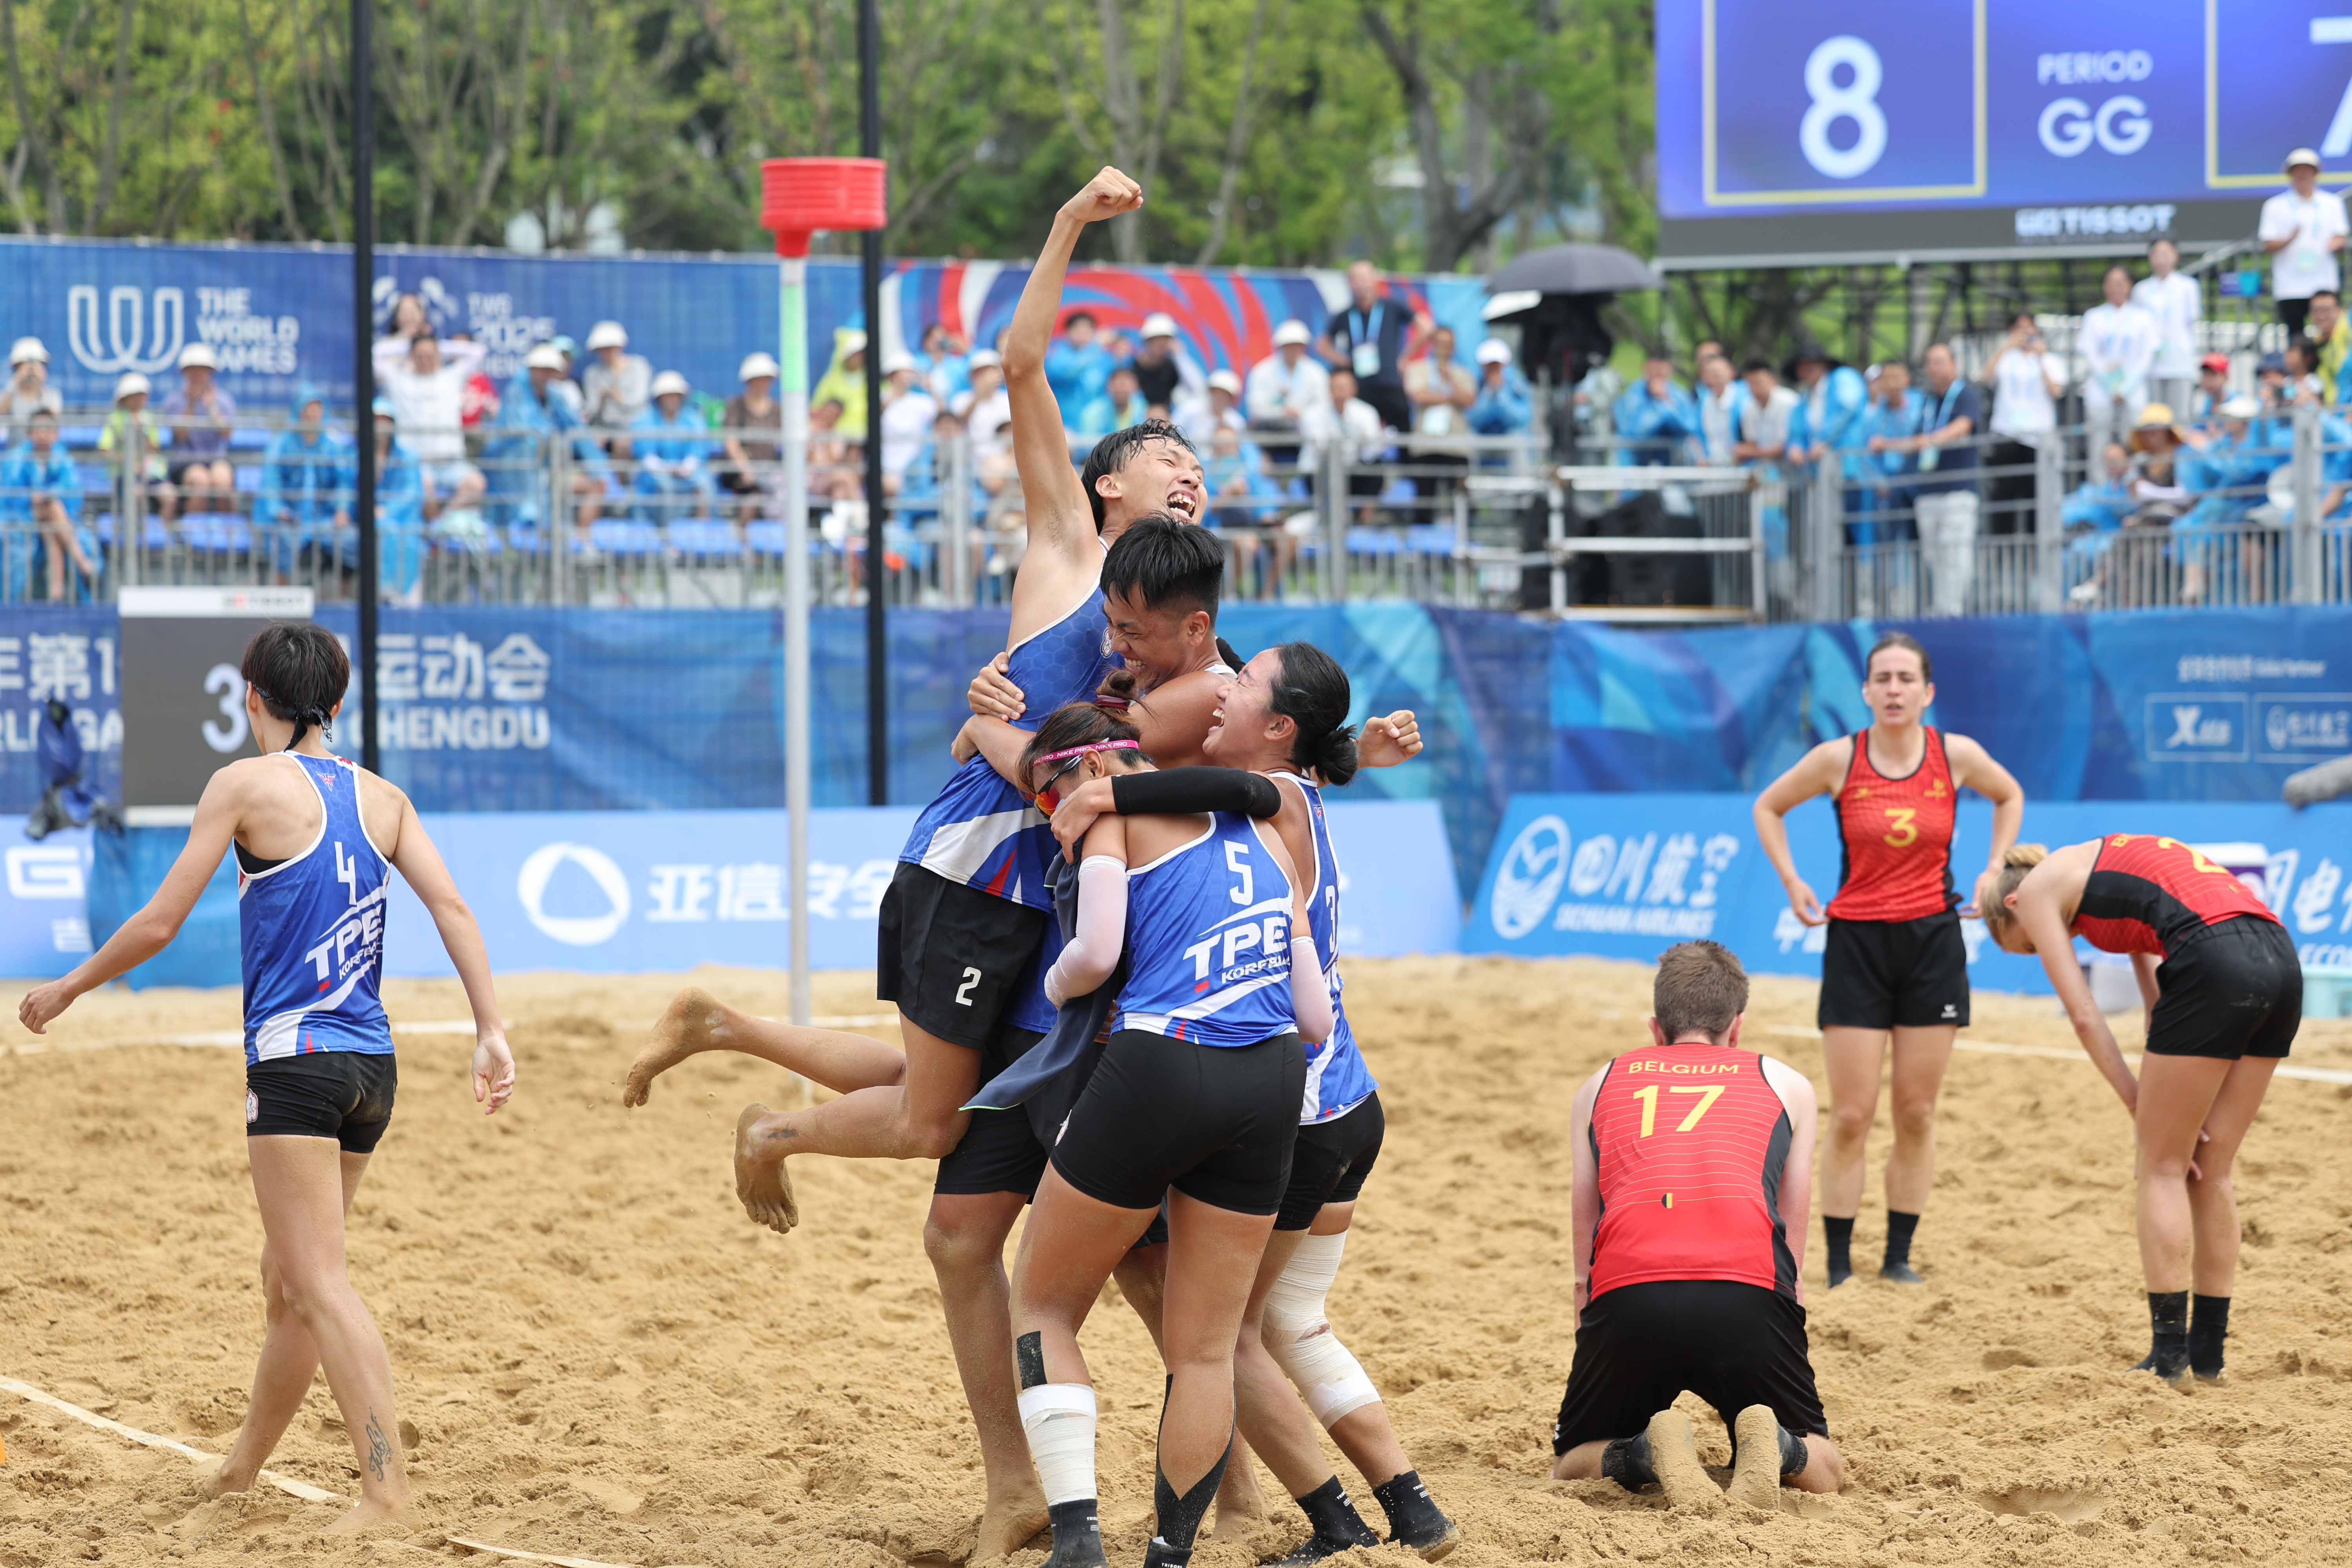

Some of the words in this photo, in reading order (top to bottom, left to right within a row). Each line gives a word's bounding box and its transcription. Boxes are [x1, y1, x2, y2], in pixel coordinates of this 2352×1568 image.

[2038, 50, 2153, 85] PERIOD
[1800, 34, 1888, 179] 8
[2038, 96, 2154, 157] GG
[2062, 204, 2177, 235] TISSOT
[197, 287, 251, 314] THE
[197, 315, 299, 345] WORLD
[212, 343, 297, 374] AMES
[376, 632, 550, 701] 运动会
[201, 662, 249, 753] 3
[1883, 808, 1918, 848] 3
[2157, 836, 2229, 874] 2
[334, 841, 357, 905] 4
[645, 858, 898, 923] 亚信安全
[1223, 840, 1253, 906] 5
[1570, 830, 1740, 909] 四川航空
[305, 903, 383, 982] TPE
[1182, 916, 1288, 981] TPE
[955, 966, 982, 1006] 2
[1628, 1060, 1739, 1074] BELGIUM
[1633, 1085, 1726, 1138] 17
